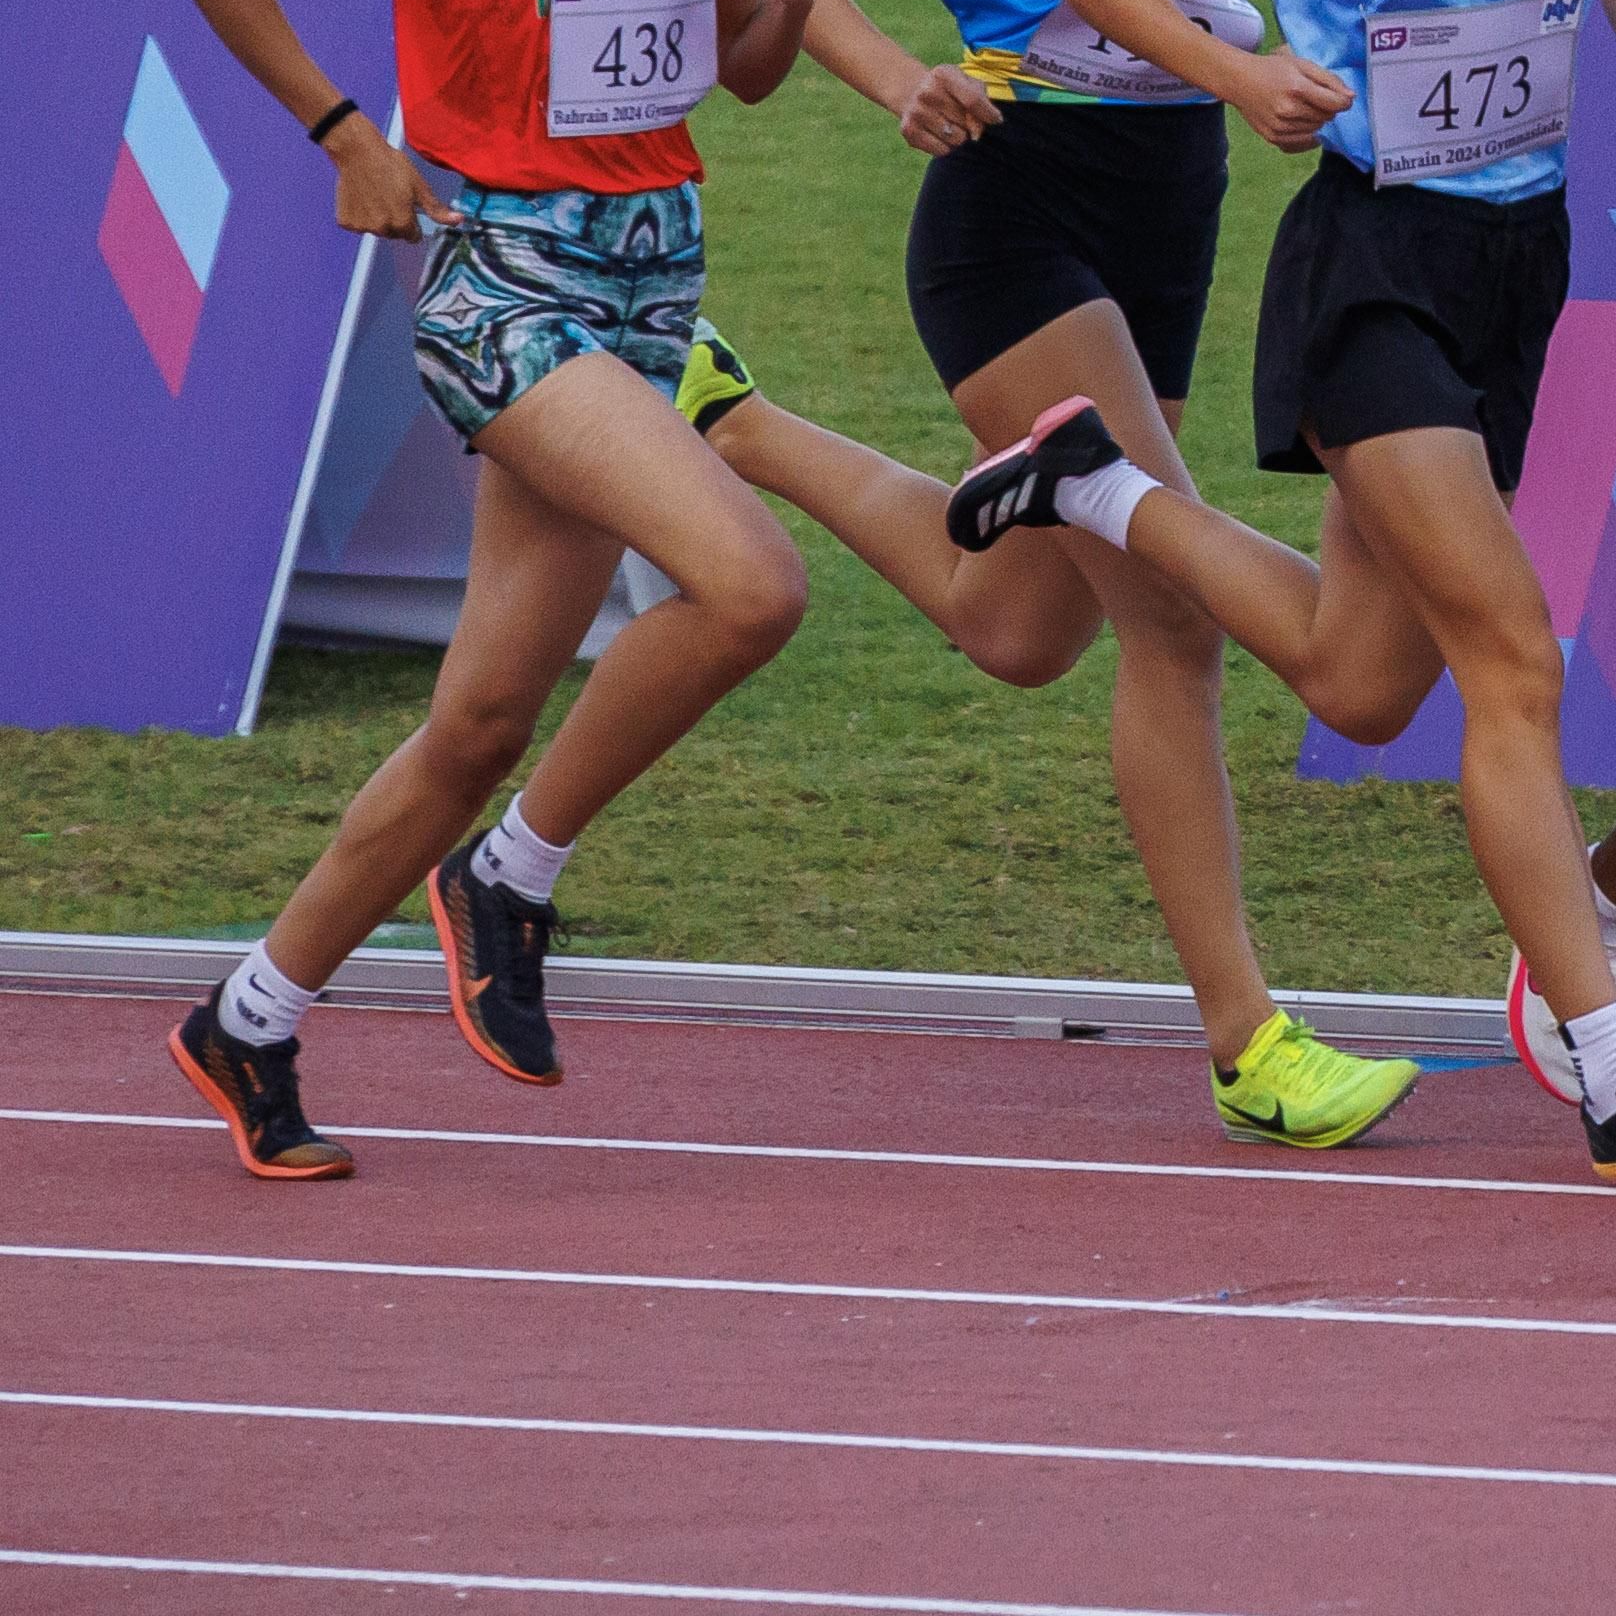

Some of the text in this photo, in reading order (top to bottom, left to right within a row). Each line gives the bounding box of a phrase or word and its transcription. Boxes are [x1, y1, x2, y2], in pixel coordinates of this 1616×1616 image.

[592, 18, 685, 88] 438
[1374, 30, 1403, 49] ISF
[1026, 51, 1091, 84] Bahrain
[1095, 70, 1134, 91] 2024
[1418, 55, 1531, 132] 473
[553, 107, 608, 126] Bahrain
[611, 104, 642, 122] 2024
[1382, 117, 1564, 175] Bahrain 2024 Gymnasiade
